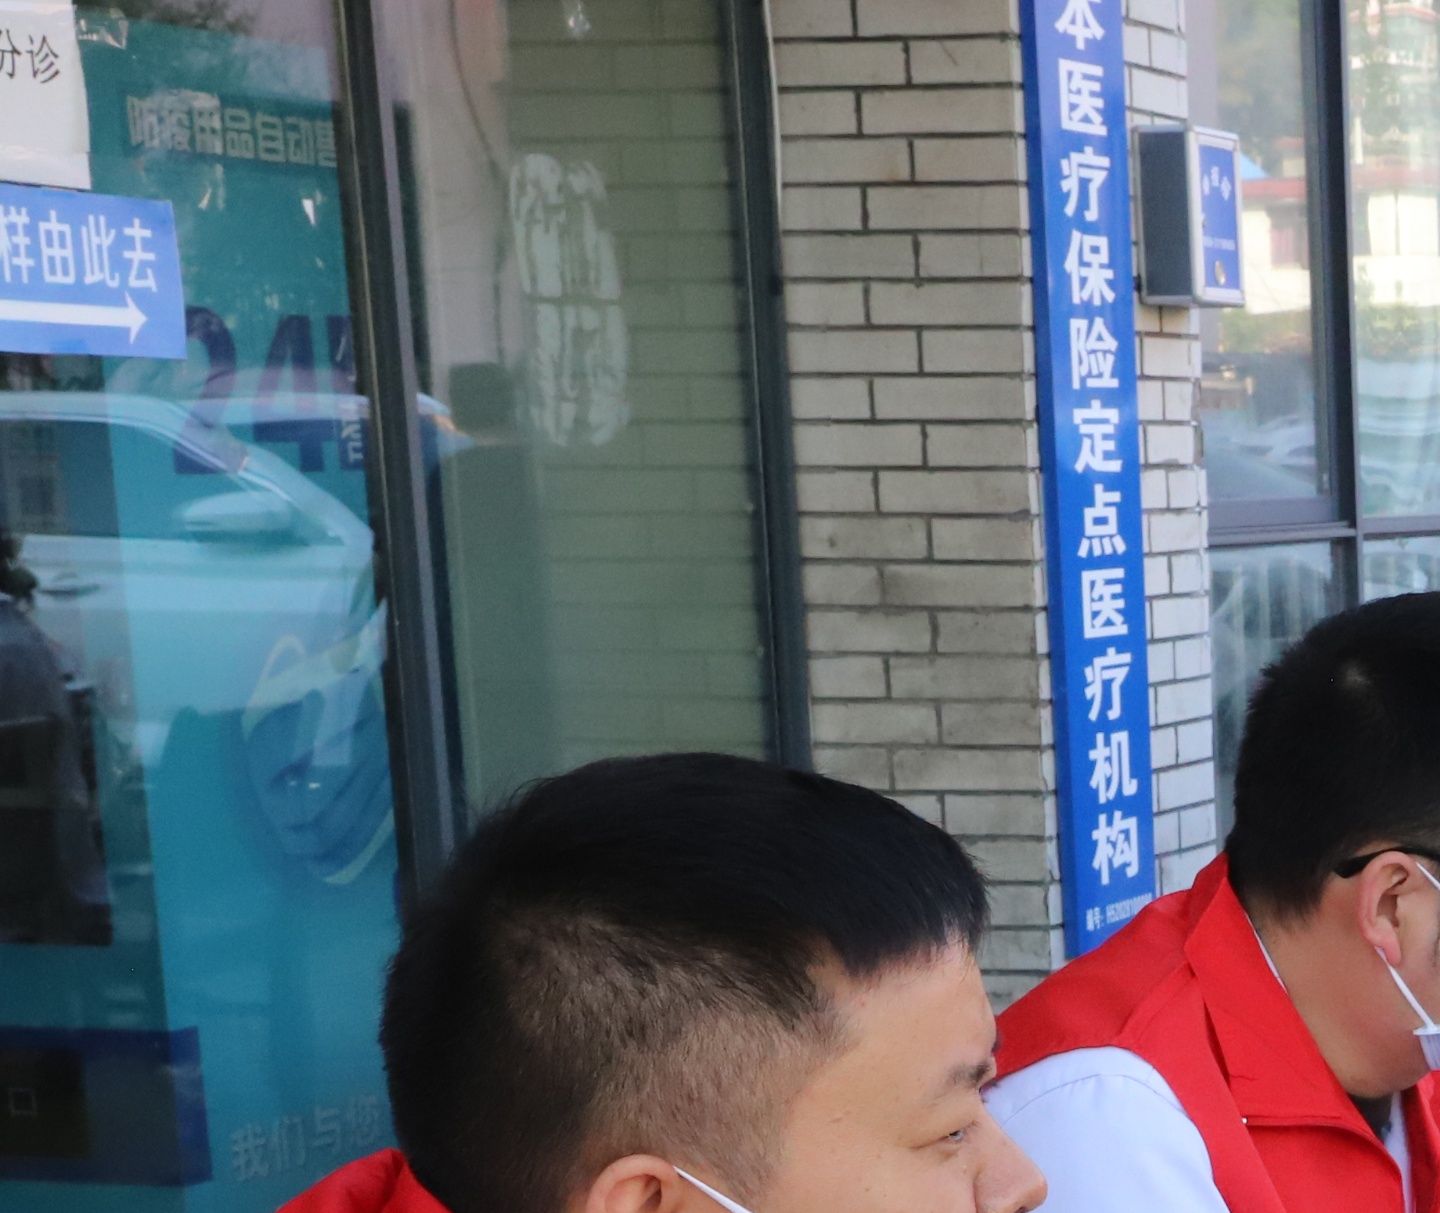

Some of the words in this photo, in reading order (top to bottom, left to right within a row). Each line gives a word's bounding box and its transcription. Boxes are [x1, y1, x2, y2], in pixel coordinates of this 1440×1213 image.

[0, 203, 158, 292] 样由此去
[1053, 0, 1140, 886] 本医疗保险定点医疗机构
